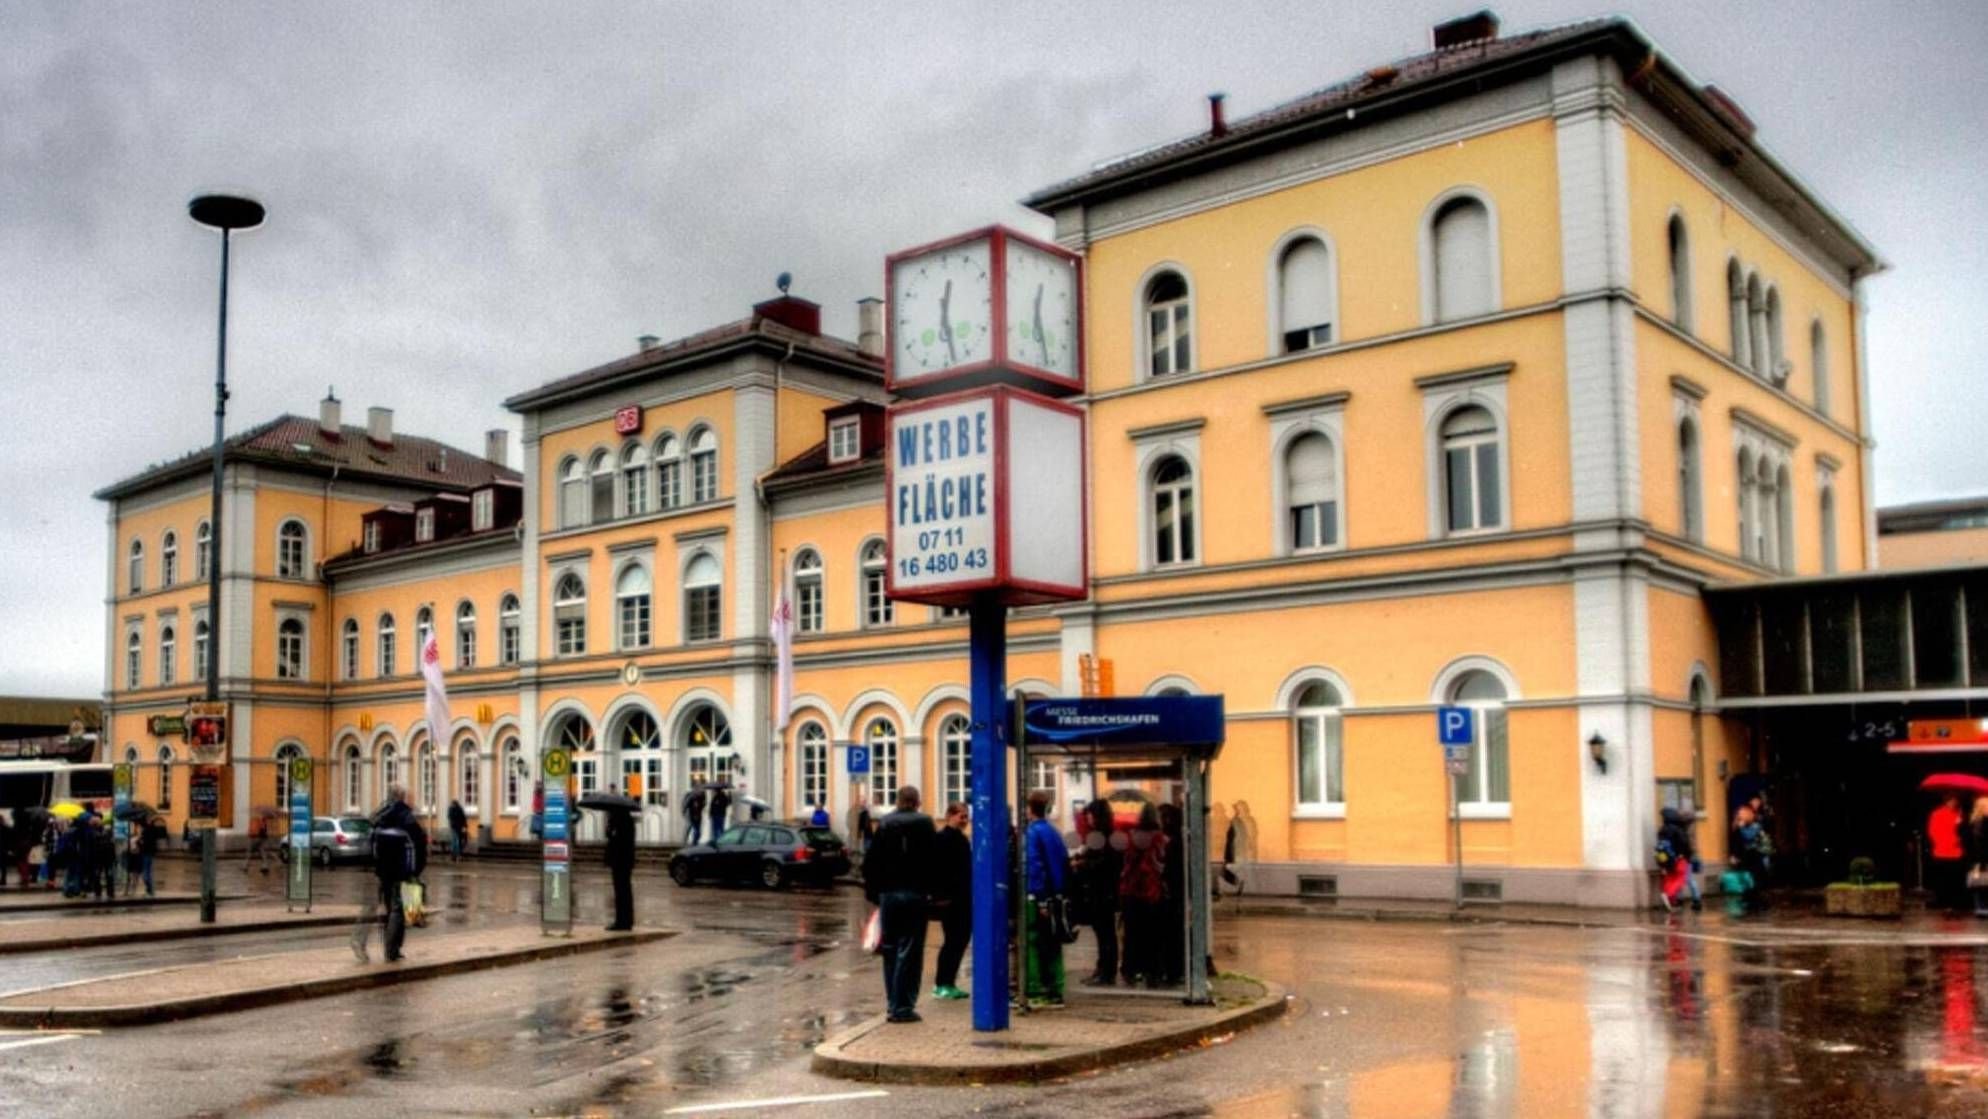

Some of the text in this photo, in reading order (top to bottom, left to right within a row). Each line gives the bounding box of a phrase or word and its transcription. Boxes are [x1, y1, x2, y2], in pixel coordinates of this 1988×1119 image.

[898, 411, 986, 467] WERBE
[899, 473, 986, 526] FLÄCHE
[900, 548, 987, 577] 16 480 43
[1045, 707, 1078, 716] MESSE
[1058, 714, 1159, 726] FRIEDRICHSHAFEN
[1446, 711, 1465, 740] P
[1864, 722, 1897, 739] 2-5
[852, 750, 866, 769] P
